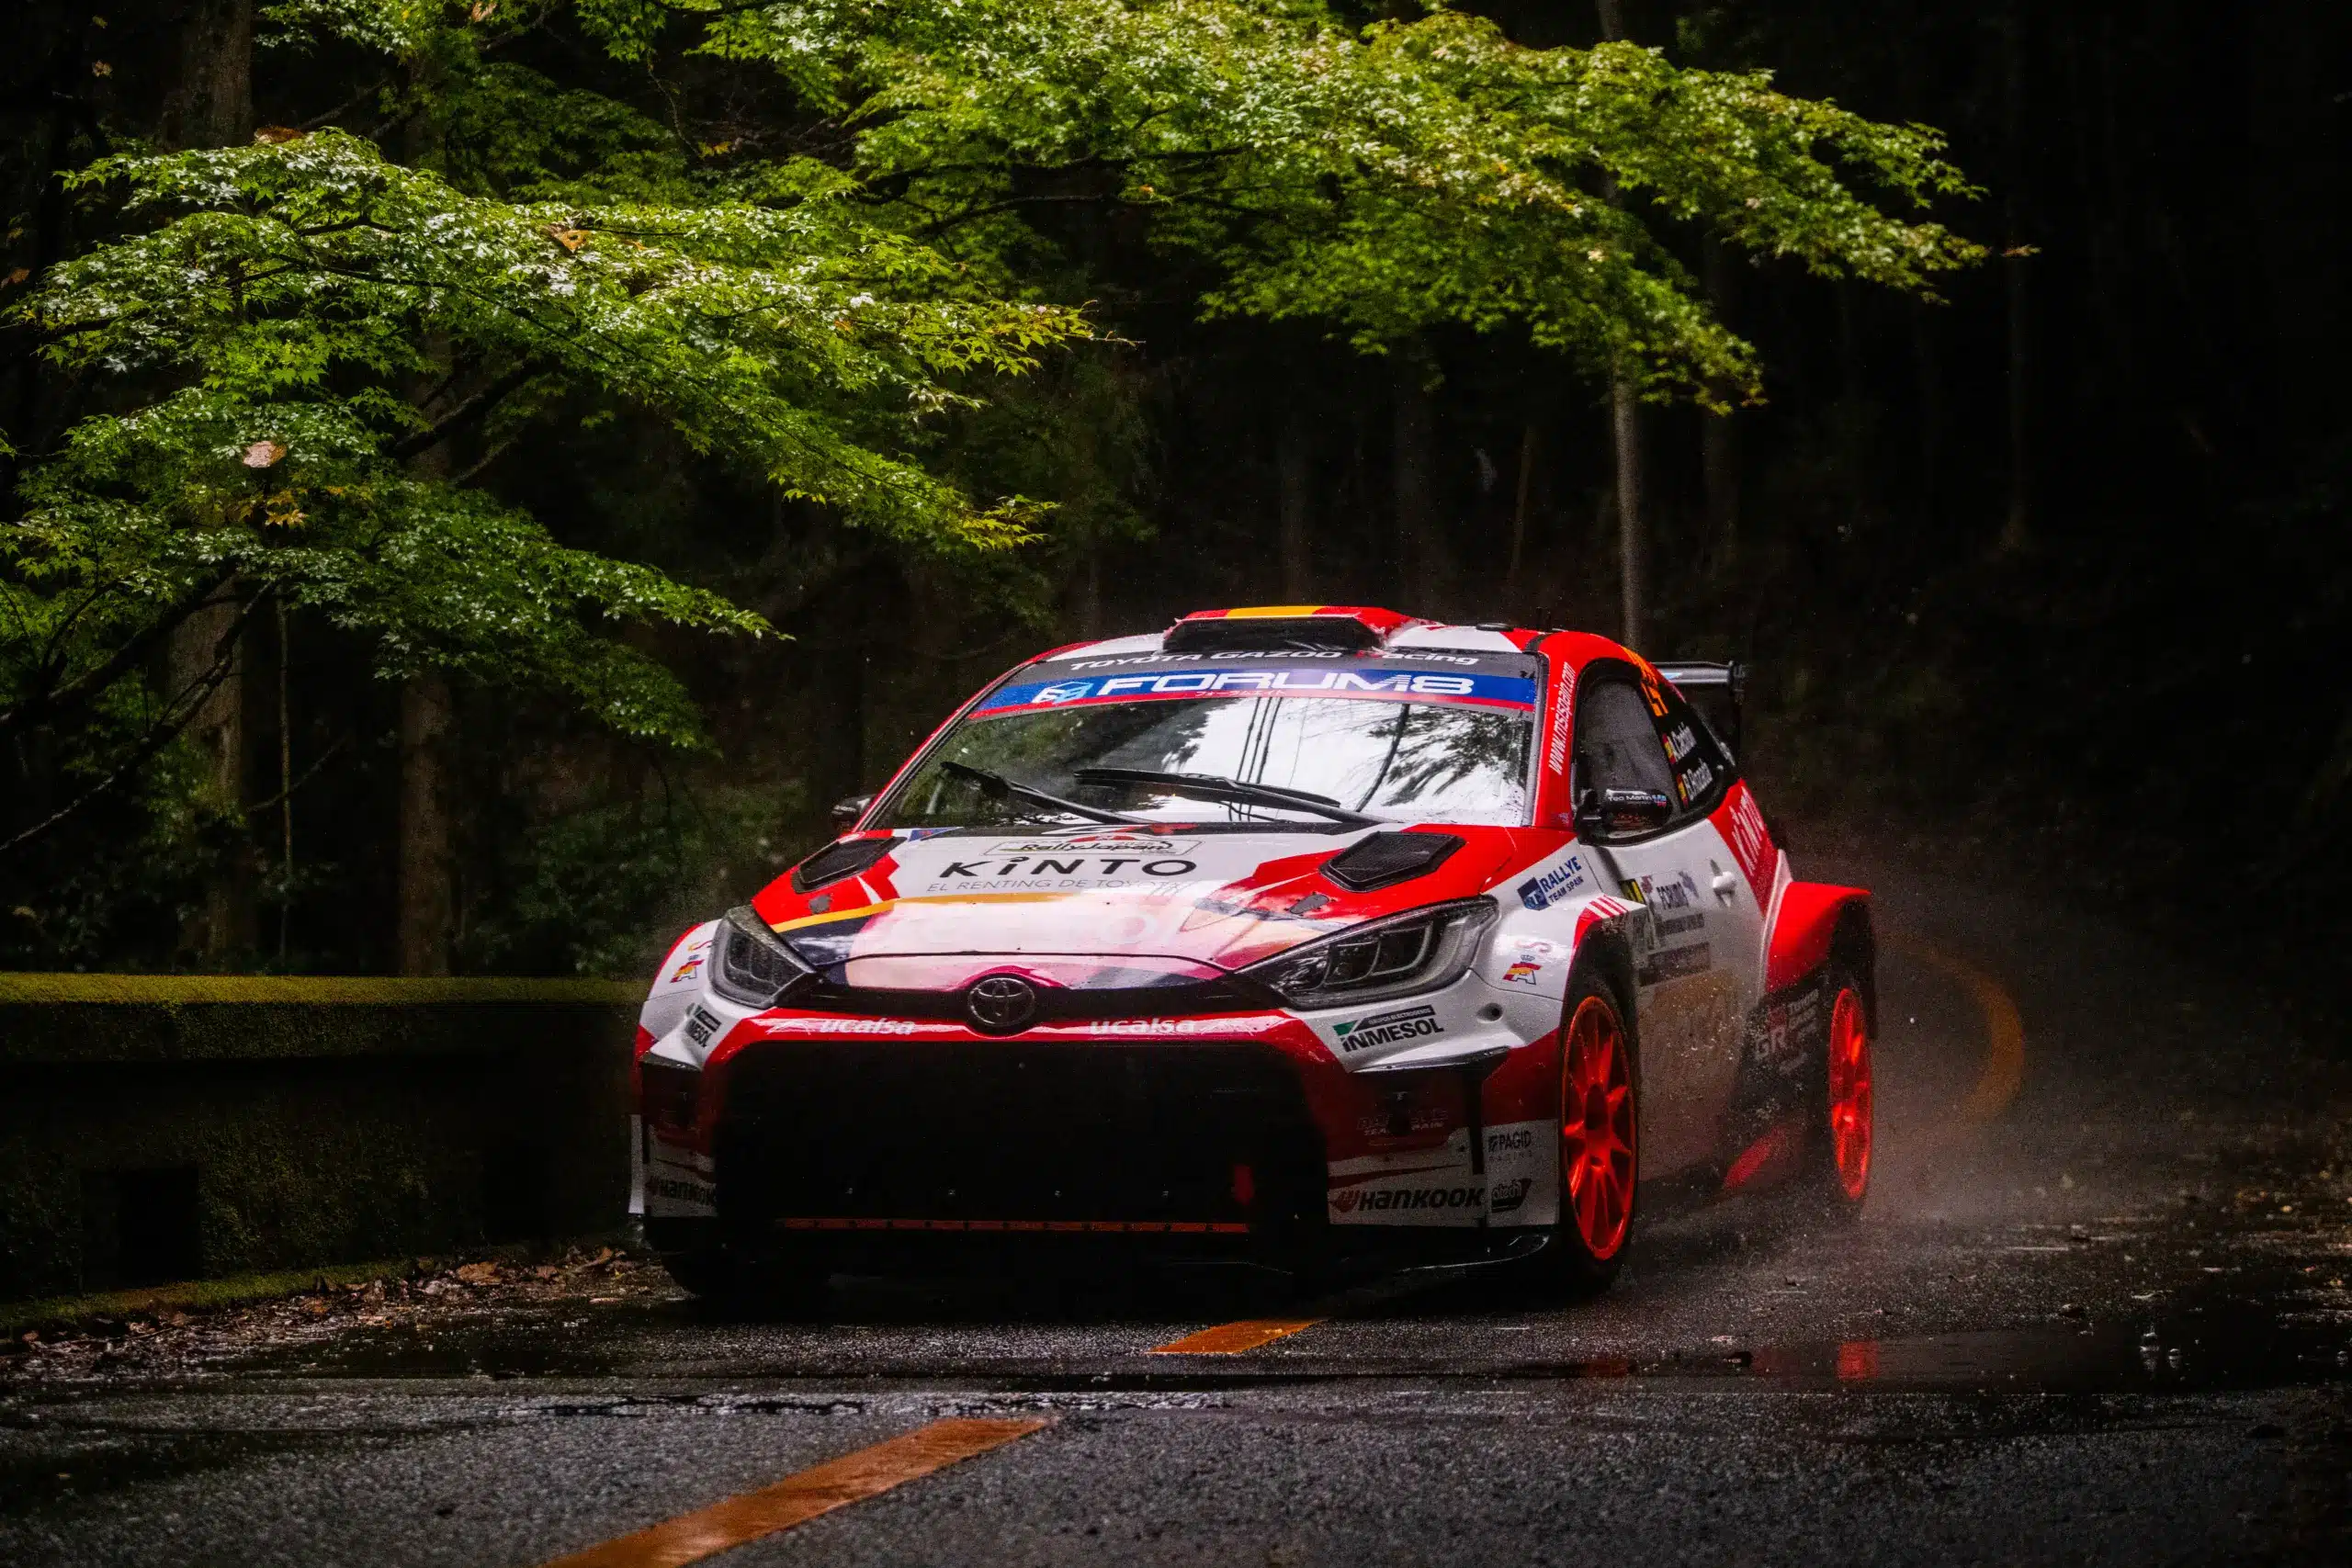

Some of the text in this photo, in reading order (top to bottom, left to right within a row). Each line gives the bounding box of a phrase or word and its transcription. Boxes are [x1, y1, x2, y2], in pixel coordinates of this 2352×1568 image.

[1070, 652, 1202, 671] TOYOTA
[1209, 650, 1343, 660] GAZOO
[1097, 671, 1476, 696] FORUM8
[1548, 661, 1577, 777] www.msispain.com
[926, 883, 949, 892] EL
[956, 879, 1052, 891] RENTING
[1058, 879, 1092, 888] DE
[1539, 855, 1582, 893] RALLYE
[1548, 874, 1585, 903] TEAM SPAIN
[1090, 1018, 1196, 1035] ucalsa
[1498, 1130, 1532, 1151] PAGID
